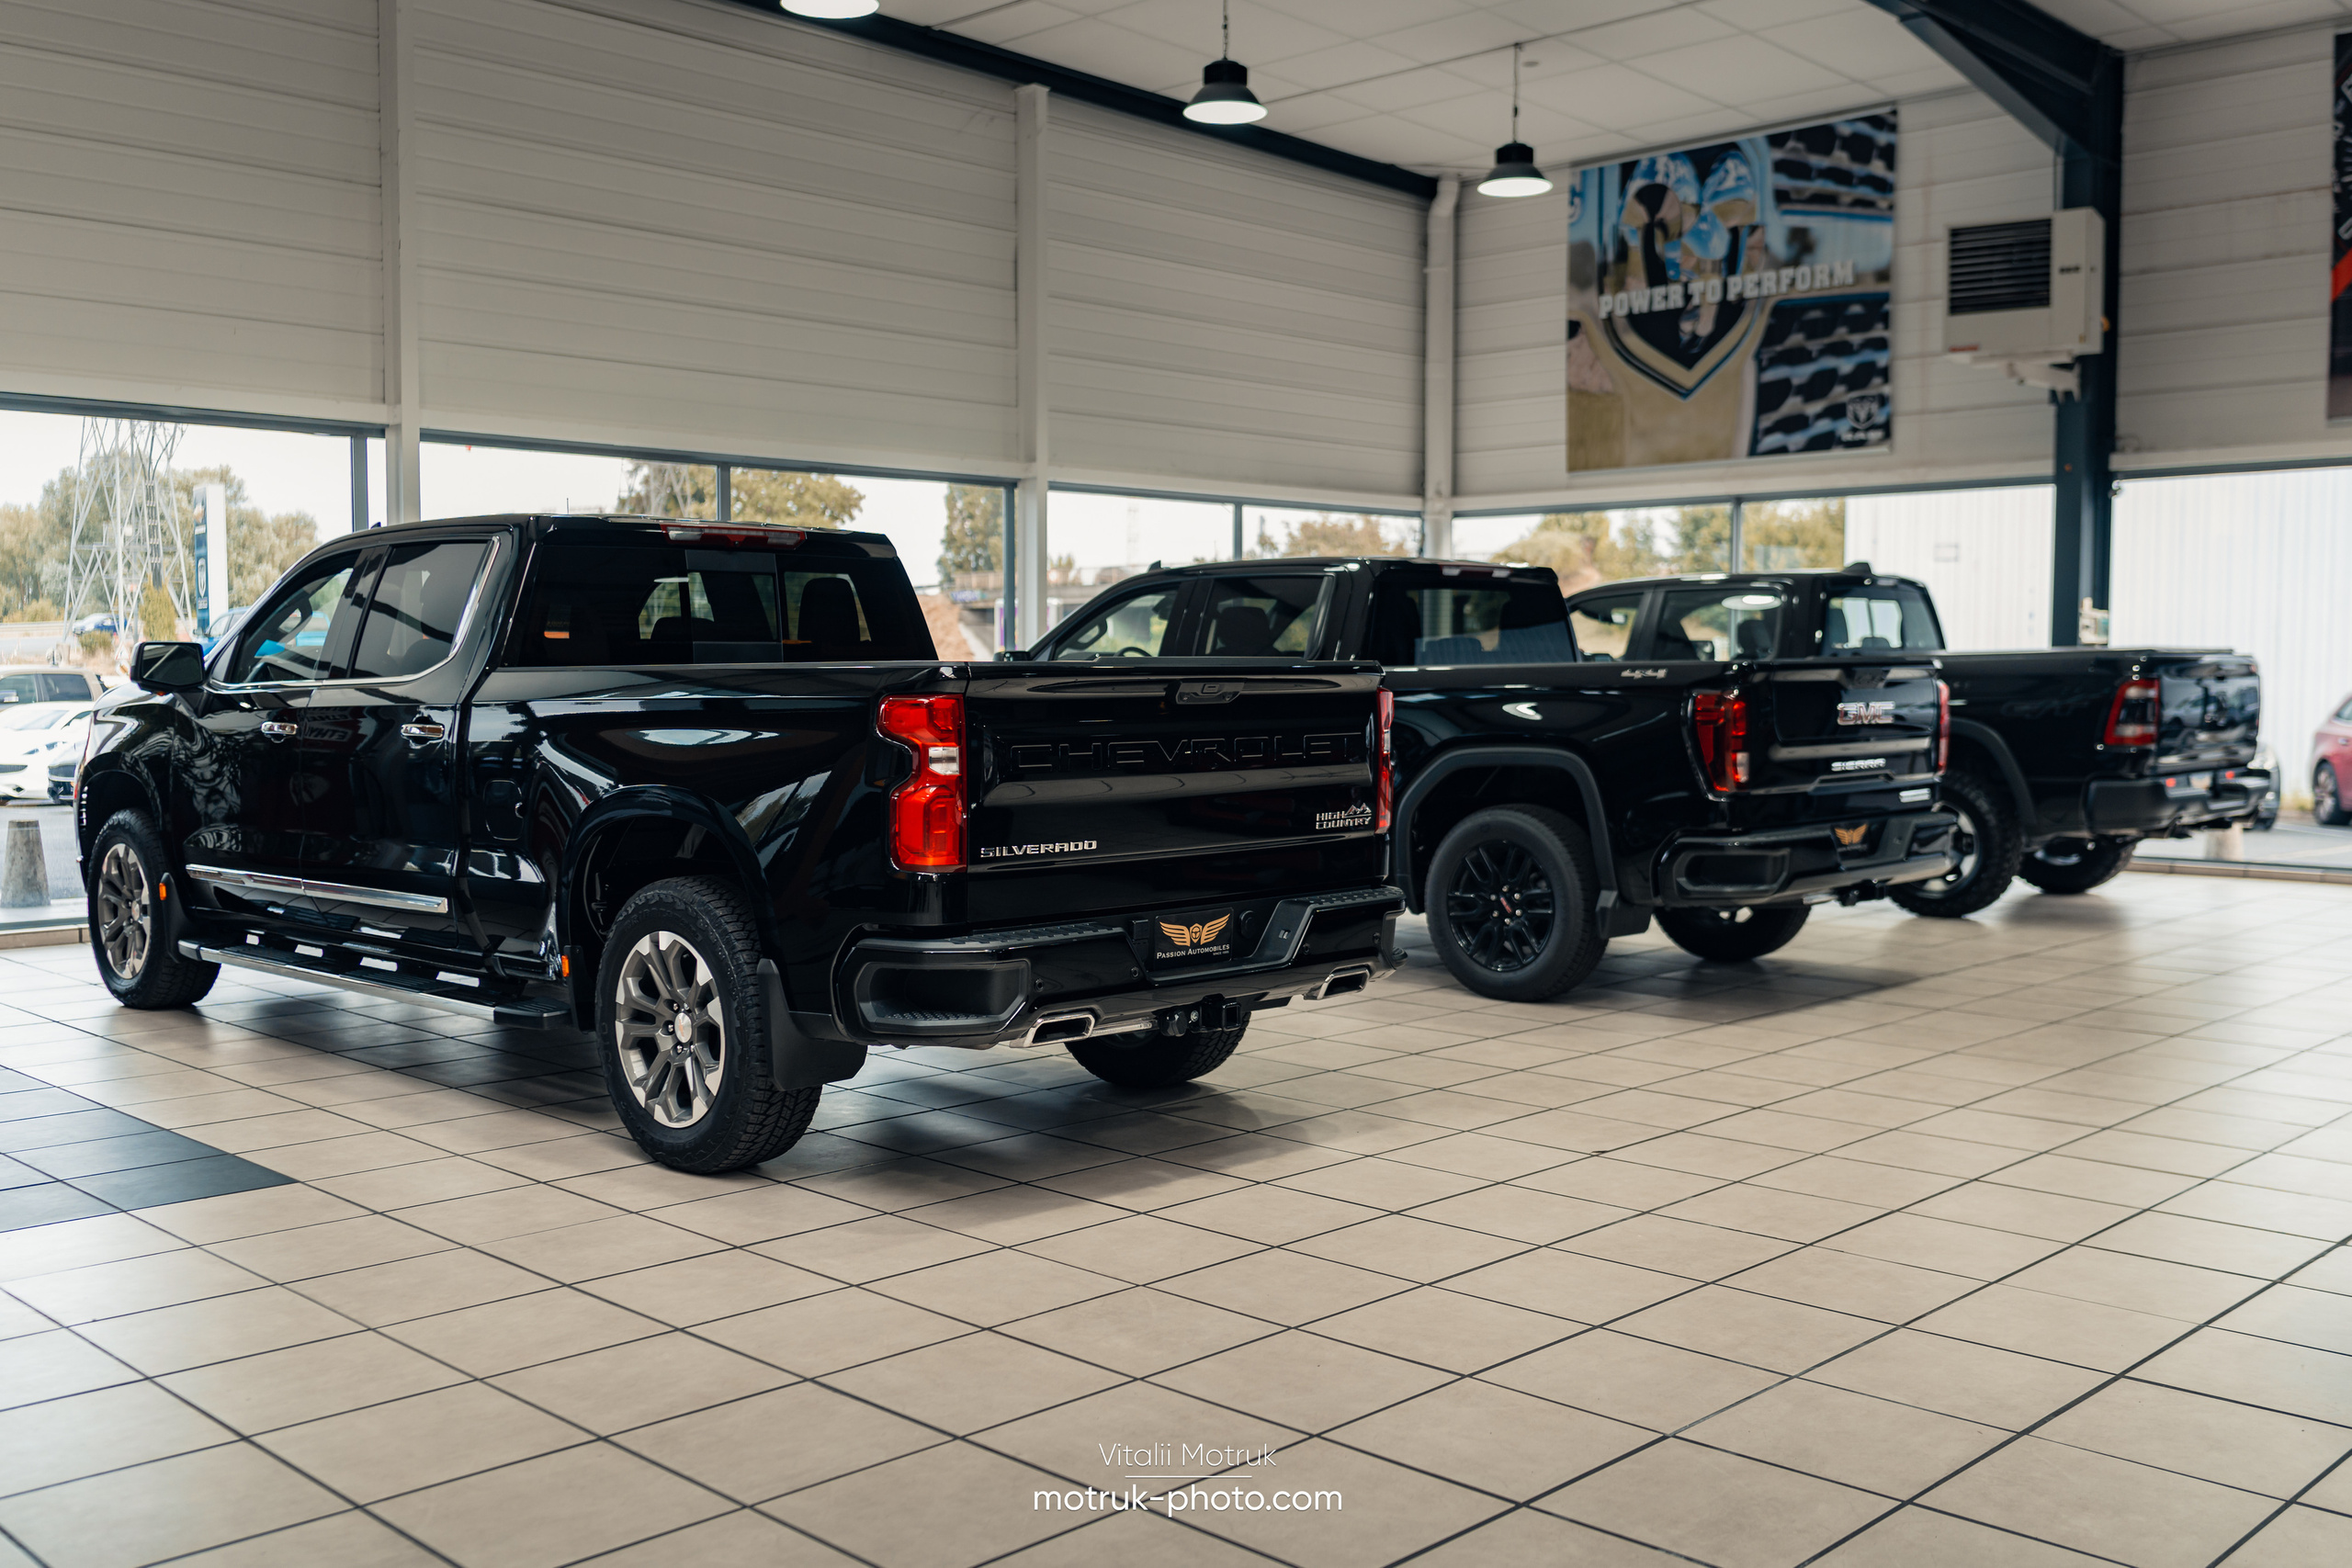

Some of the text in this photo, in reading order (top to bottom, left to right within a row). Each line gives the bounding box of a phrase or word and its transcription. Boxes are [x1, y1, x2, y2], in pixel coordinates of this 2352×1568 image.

[1599, 260, 1855, 320] POWER TO PERFORM
[1838, 701, 1895, 726] GMC
[1012, 732, 1361, 772] CHEVROLET
[1831, 758, 1886, 772] SIERRA
[1316, 811, 1345, 821] HIGH
[1316, 817, 1372, 829] COUNTRY
[980, 840, 1097, 858] SILVERADO
